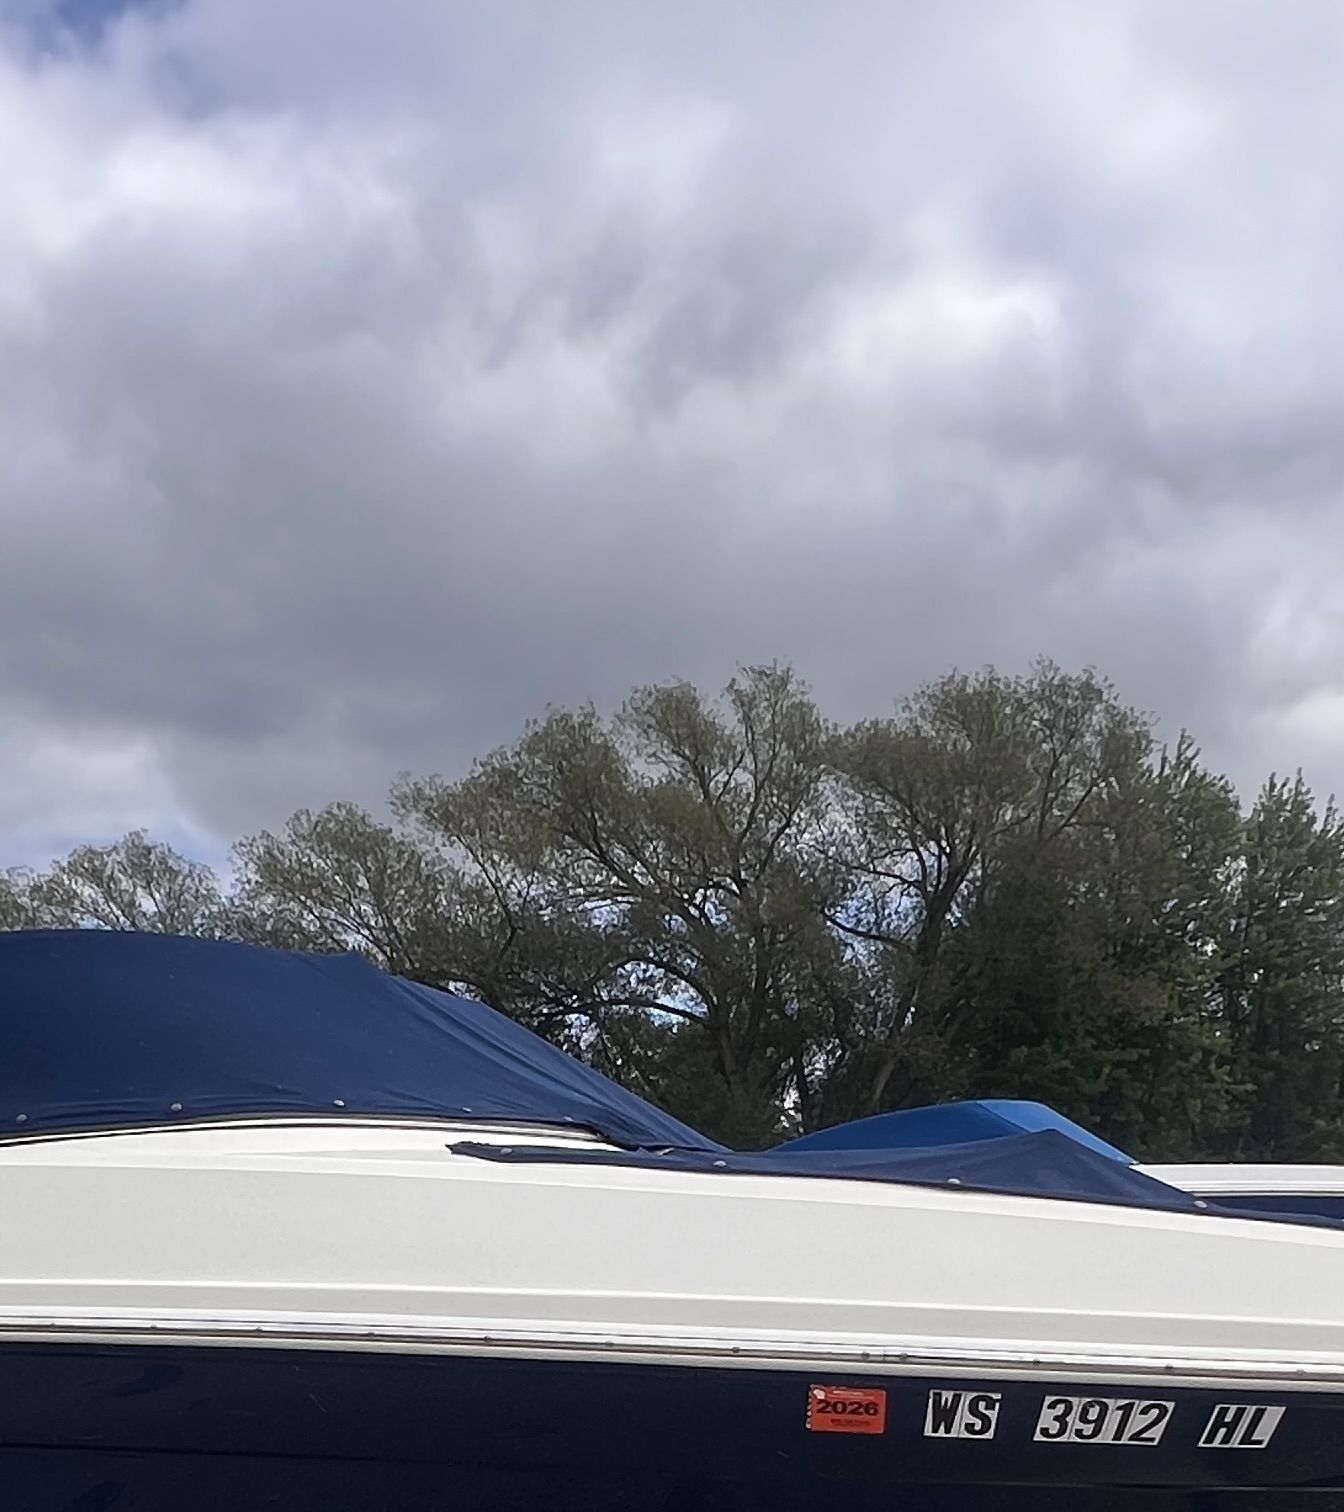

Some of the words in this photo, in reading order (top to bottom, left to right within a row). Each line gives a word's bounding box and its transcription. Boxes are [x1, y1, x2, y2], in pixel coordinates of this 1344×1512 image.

[816, 1400, 880, 1416] 2026
[931, 1392, 1000, 1435] WS
[1039, 1398, 1169, 1443] 3912
[1202, 1407, 1267, 1446] HL
